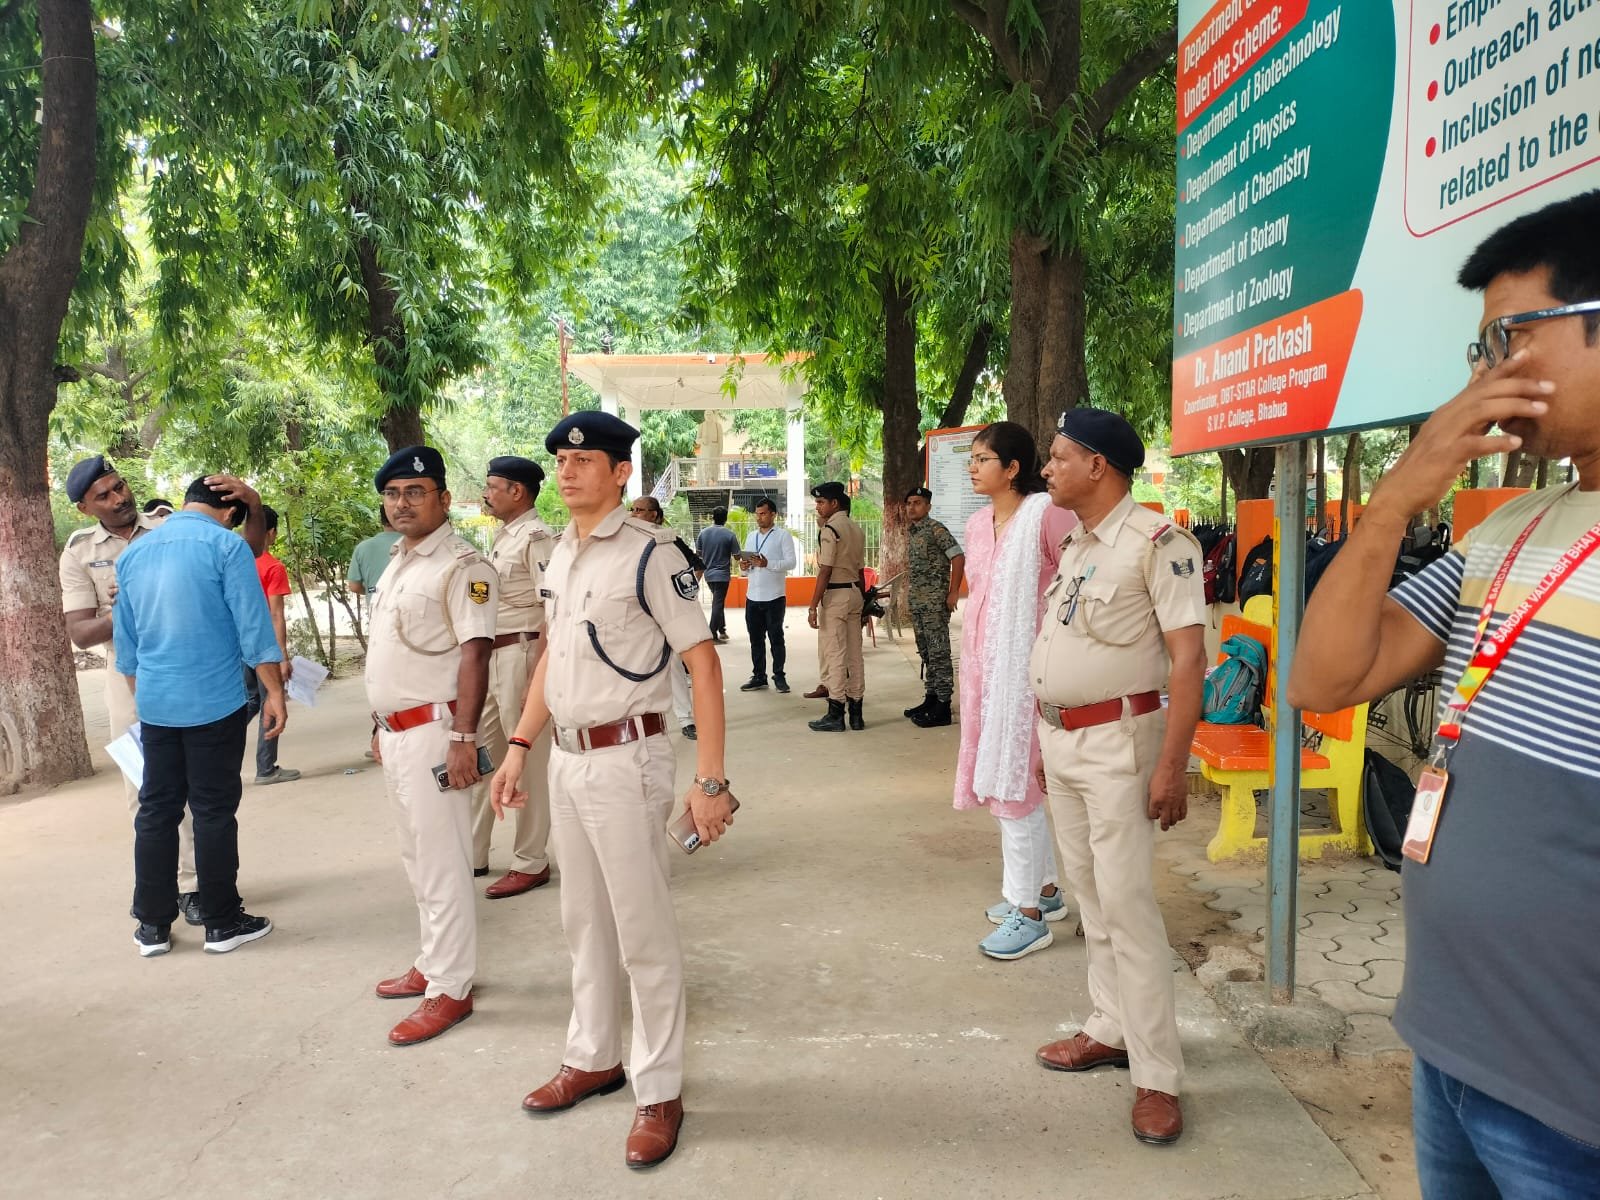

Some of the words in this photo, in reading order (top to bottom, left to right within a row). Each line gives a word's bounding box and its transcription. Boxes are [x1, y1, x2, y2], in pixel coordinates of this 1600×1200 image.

[1184, 0, 1243, 74] Department
[1184, 71, 1212, 118] Under
[1213, 53, 1231, 91] the
[1232, 5, 1282, 72] Scheme:
[1187, 92, 1238, 160] Department
[1240, 78, 1252, 113] of
[1254, 5, 1341, 102] Biotechnology
[1444, 7, 1539, 96] Outreach
[1442, 75, 1536, 154] Inclusion
[1545, 46, 1569, 96] of
[1185, 191, 1236, 248] Department
[1238, 180, 1249, 213] of
[1251, 145, 1311, 204] Chemistry
[1186, 142, 1237, 204] Department
[1239, 130, 1250, 163] of
[1252, 100, 1296, 154] Physics
[1439, 142, 1510, 209] related
[1519, 135, 1539, 172] to
[1549, 113, 1588, 158] the
[1184, 247, 1235, 293] Department
[1237, 231, 1248, 263] of
[1250, 214, 1289, 257] Botany
[1183, 293, 1234, 338] Department
[1236, 283, 1247, 310] of
[1248, 265, 1294, 307] Zoology
[1194, 357, 1210, 388] Dr.
[1212, 336, 1250, 382] Anand
[1253, 315, 1312, 368] Prakash
[1220, 380, 1256, 405] DBT-STAR
[1257, 374, 1287, 395] College
[1289, 363, 1327, 388] Program
[1207, 413, 1227, 432] S.V.P.
[1228, 408, 1256, 428] College,
[1258, 401, 1287, 421] Bhabua
[1492, 600, 1532, 643] SARDAR
[1527, 552, 1573, 604] VALLABH
[1566, 531, 1596, 560] BHAI
